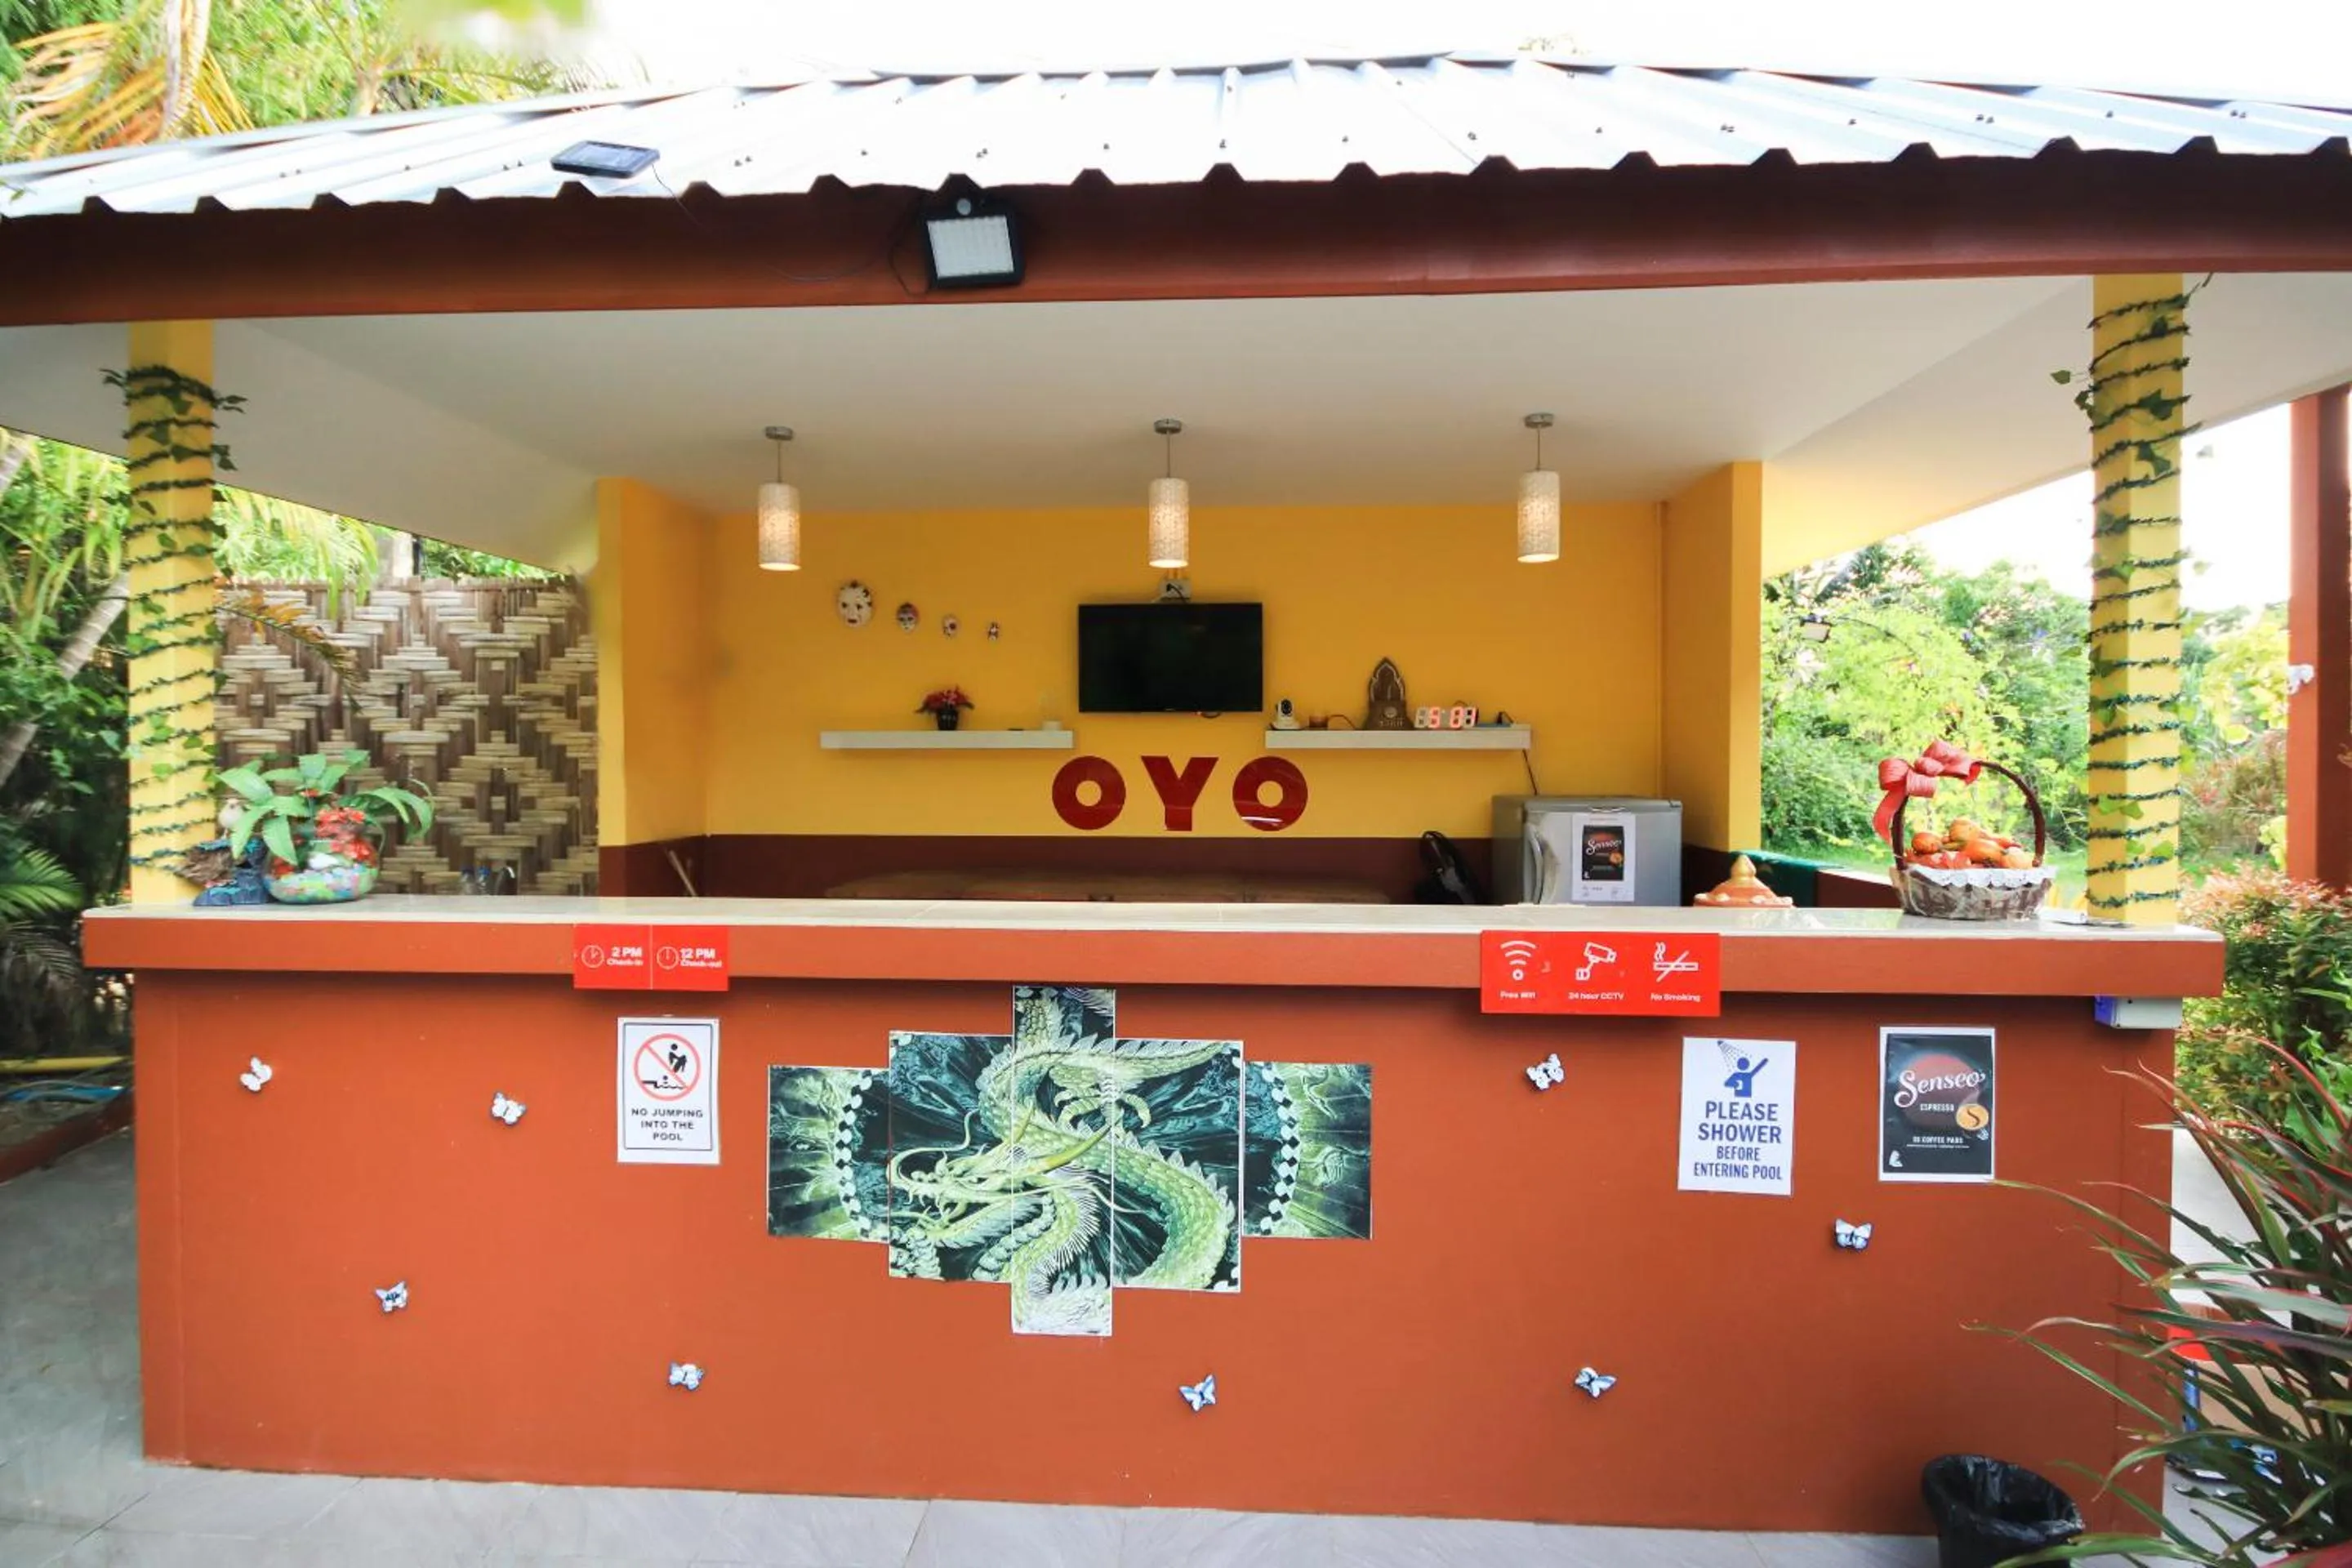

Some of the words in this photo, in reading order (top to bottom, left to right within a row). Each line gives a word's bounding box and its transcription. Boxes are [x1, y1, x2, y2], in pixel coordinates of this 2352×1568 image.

[1052, 755, 1308, 831] OYO
[612, 947, 620, 957] 2
[622, 947, 642, 957] PM
[679, 947, 693, 959] 12
[696, 948, 715, 959] PM
[606, 958, 644, 966] Check-in
[1499, 990, 1518, 999] Free
[1568, 991, 1579, 1000] 24
[1580, 991, 1600, 1000] hour
[1601, 991, 1624, 1000] CCTV
[1650, 992, 1663, 1001] No
[1664, 993, 1700, 1003] Smoking
[1894, 1070, 1986, 1107] Senseo
[1705, 1100, 1779, 1122] PLEASE
[1920, 1102, 1954, 1111] ESPRESSO
[631, 1107, 648, 1116] NO
[652, 1108, 704, 1118] JUMPING
[640, 1120, 668, 1129] INTO
[672, 1120, 695, 1129] THE
[653, 1132, 683, 1142] POOL
[1698, 1122, 1782, 1143] SHOWER
[1716, 1145, 1761, 1161] BEFORE
[1694, 1161, 1748, 1178] ENTERING
[1753, 1165, 1783, 1180] POOL
